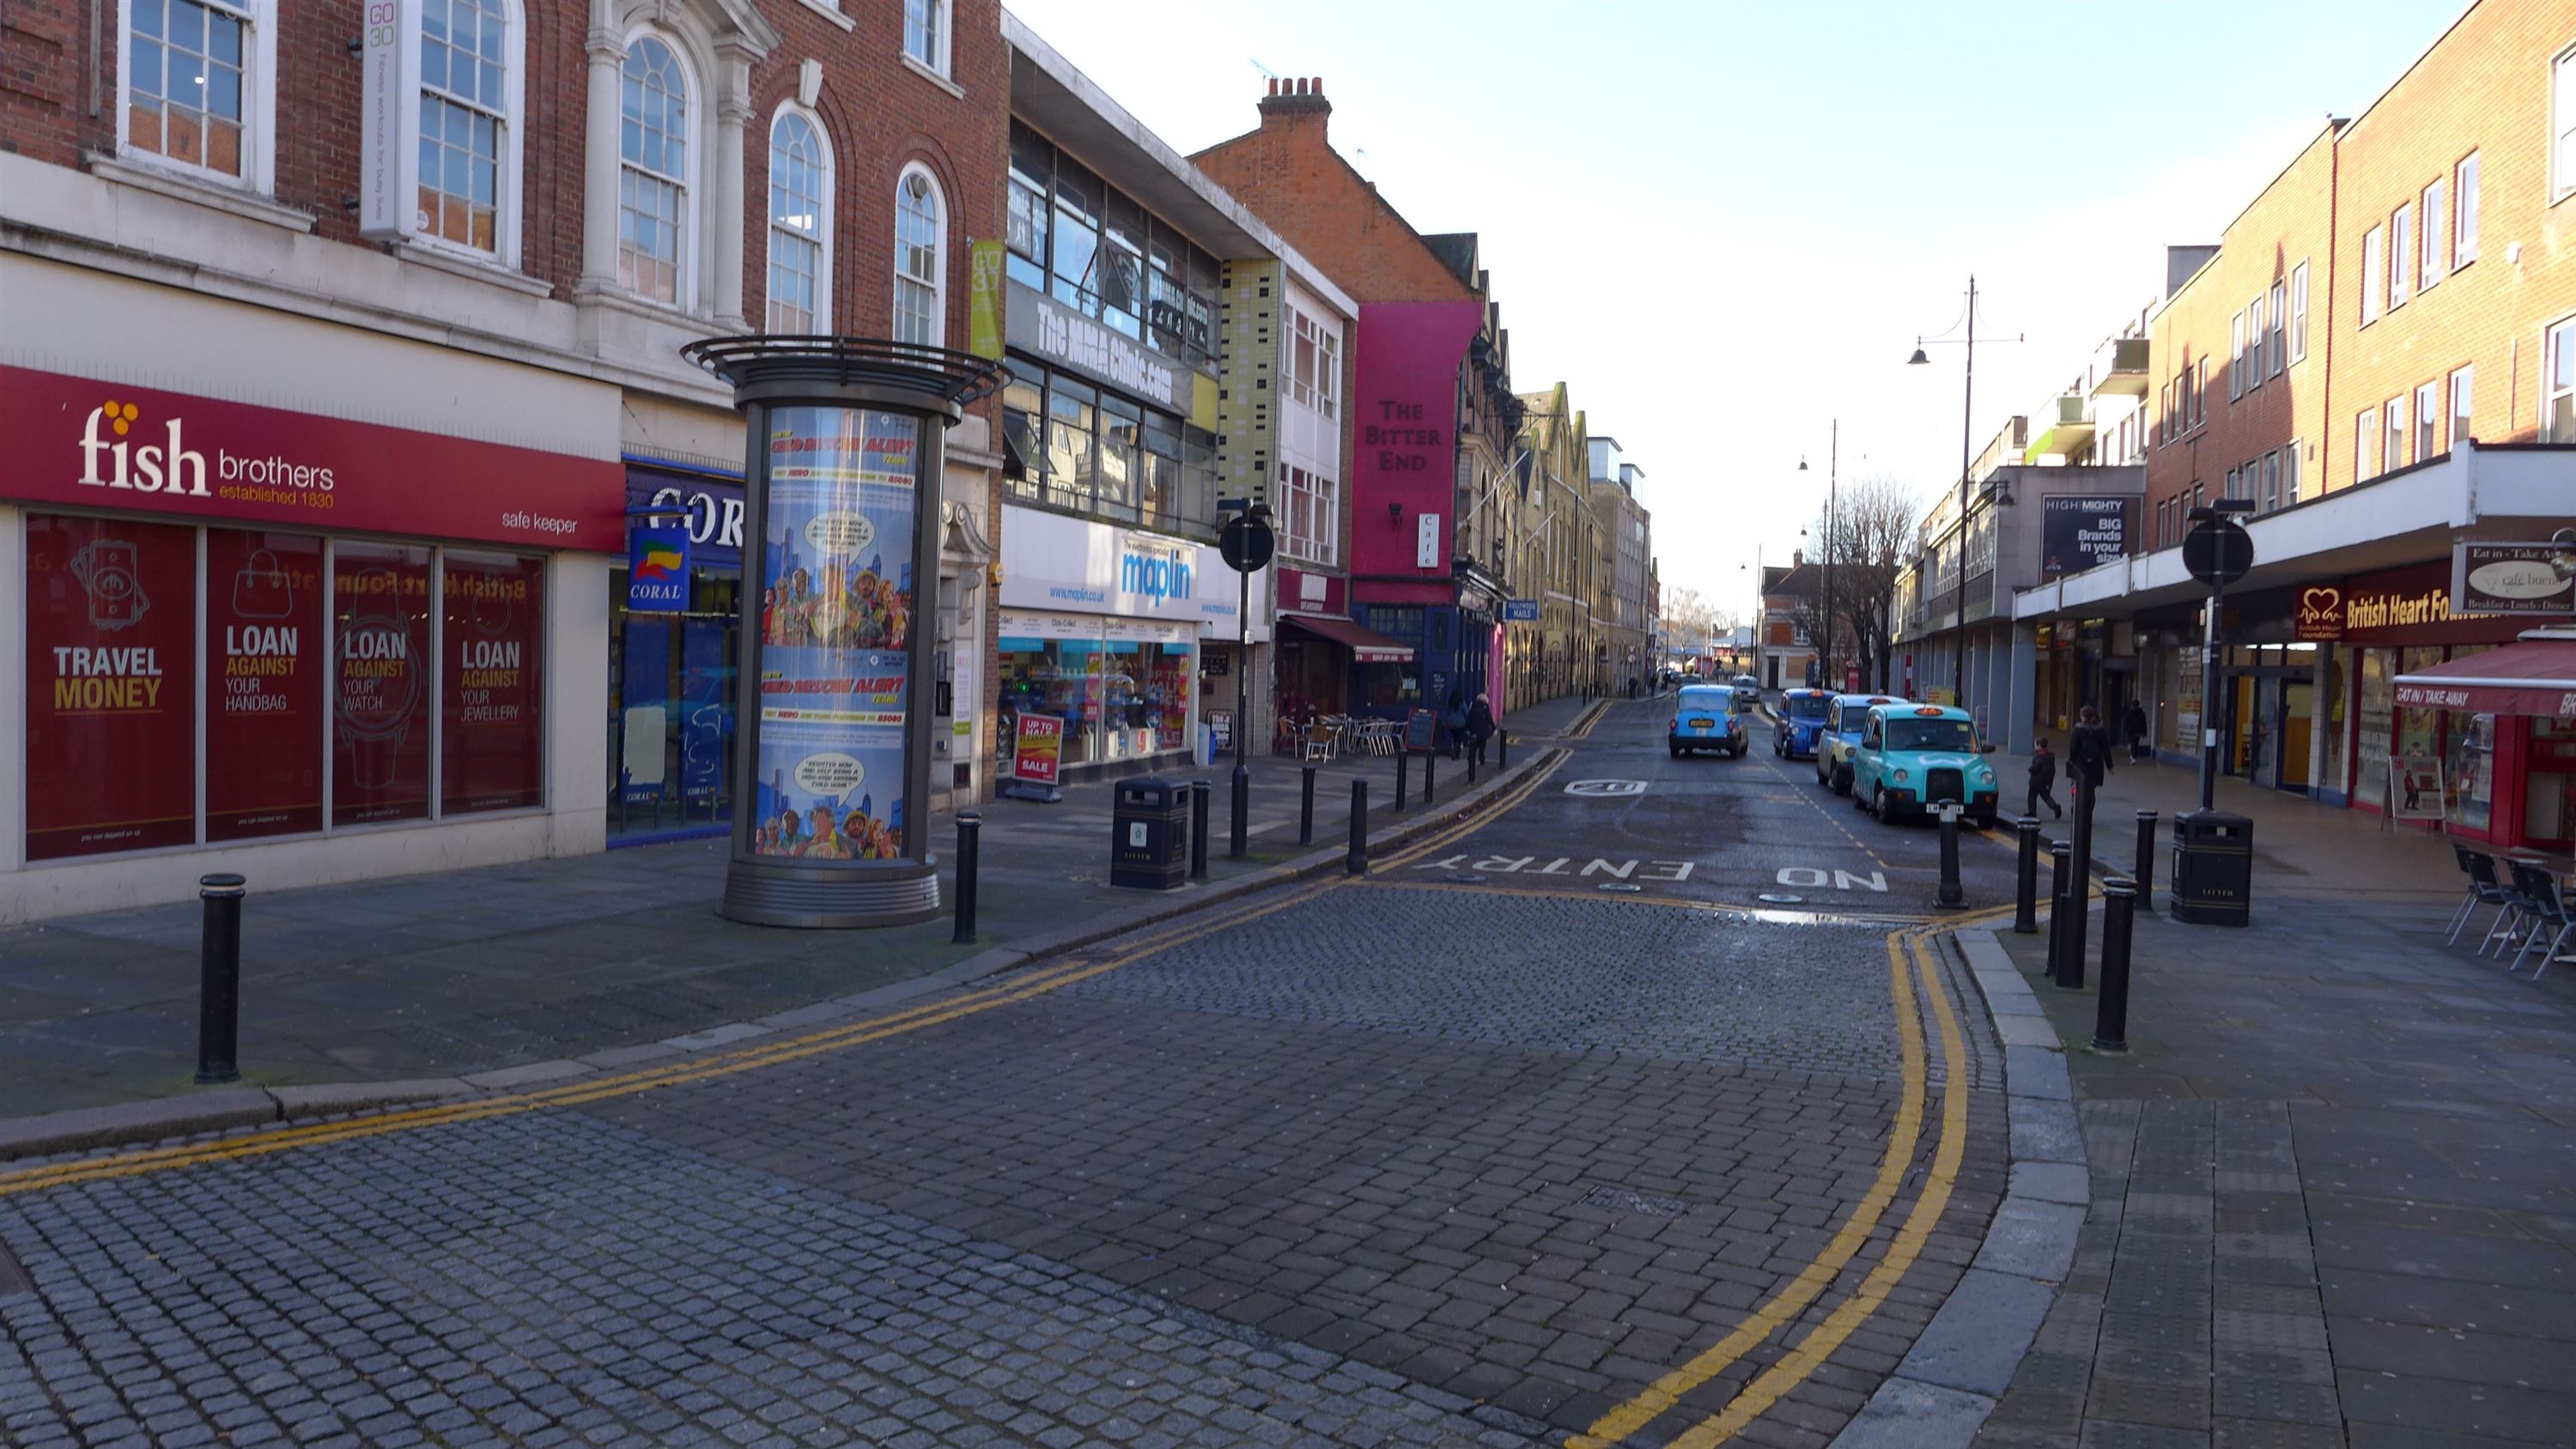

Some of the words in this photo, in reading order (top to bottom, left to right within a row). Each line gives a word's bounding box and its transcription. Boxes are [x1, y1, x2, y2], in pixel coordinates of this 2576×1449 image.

[370, 26, 394, 47] 30
[378, 54, 386, 93] Fitness
[376, 96, 385, 146] workouts
[376, 149, 385, 166] for
[374, 169, 385, 196] busy
[375, 197, 384, 221] lives
[1037, 301, 1066, 356] The
[1068, 316, 1109, 376] MMA
[1109, 336, 1173, 405] Clinic.com
[1379, 398, 1424, 420] THE
[1365, 425, 1442, 446] BITTER
[78, 405, 211, 497] fish
[865, 436, 915, 455] ALERT
[219, 447, 334, 490] brothers
[1379, 451, 1426, 471] END
[788, 469, 810, 477] HERO
[219, 485, 296, 505] established
[301, 492, 334, 508] 1830
[2046, 500, 2078, 510] HIGH
[2081, 500, 2123, 510] MIGHTY
[502, 511, 531, 529] safe
[533, 513, 578, 535] keeper
[2099, 518, 2122, 530] BIG
[2078, 529, 2122, 541] Brands
[2080, 541, 2091, 552] in
[2093, 542, 2122, 555] your
[2473, 548, 2489, 558] Eat
[2492, 549, 2502, 558] in
[2511, 549, 2539, 559] Take
[1122, 548, 1190, 608] maplin
[630, 585, 680, 599] CORAL
[1050, 585, 1105, 604] www.maplin.co.uk
[2347, 595, 2386, 630] British
[2389, 592, 2429, 626] Heart
[2469, 599, 2504, 609] Breakfast
[1513, 609, 1531, 619] NAILS
[227, 625, 298, 656] LOAN
[2299, 631, 2342, 640] Foundation
[344, 631, 406, 659] LOAN
[53, 646, 162, 676] TRAVEL
[462, 640, 520, 669] LOAN
[226, 657, 296, 676] AGAINST
[343, 660, 405, 677] AGAINST
[226, 677, 260, 694] YOUR
[343, 679, 374, 694] YOUR
[461, 670, 519, 688] AGAINST
[854, 676, 904, 694] ALERT
[54, 676, 162, 709] MONEY
[461, 689, 489, 705] YOUR
[2411, 688, 2421, 702] IN
[2425, 689, 2446, 705] TAKE
[2445, 691, 2470, 706] AWAY
[226, 694, 287, 712] HANDBAG
[343, 695, 383, 712] WATCH
[461, 706, 519, 722] JEWELLERY
[777, 710, 799, 719] HERO
[1026, 719, 1040, 730] UP
[1041, 721, 1053, 731] TO
[1022, 759, 1049, 773] SALE
[627, 791, 649, 802] CORAL
[687, 786, 708, 796] CORAL
[1412, 854, 1695, 881] ENTRY
[1776, 867, 1888, 892] NO
